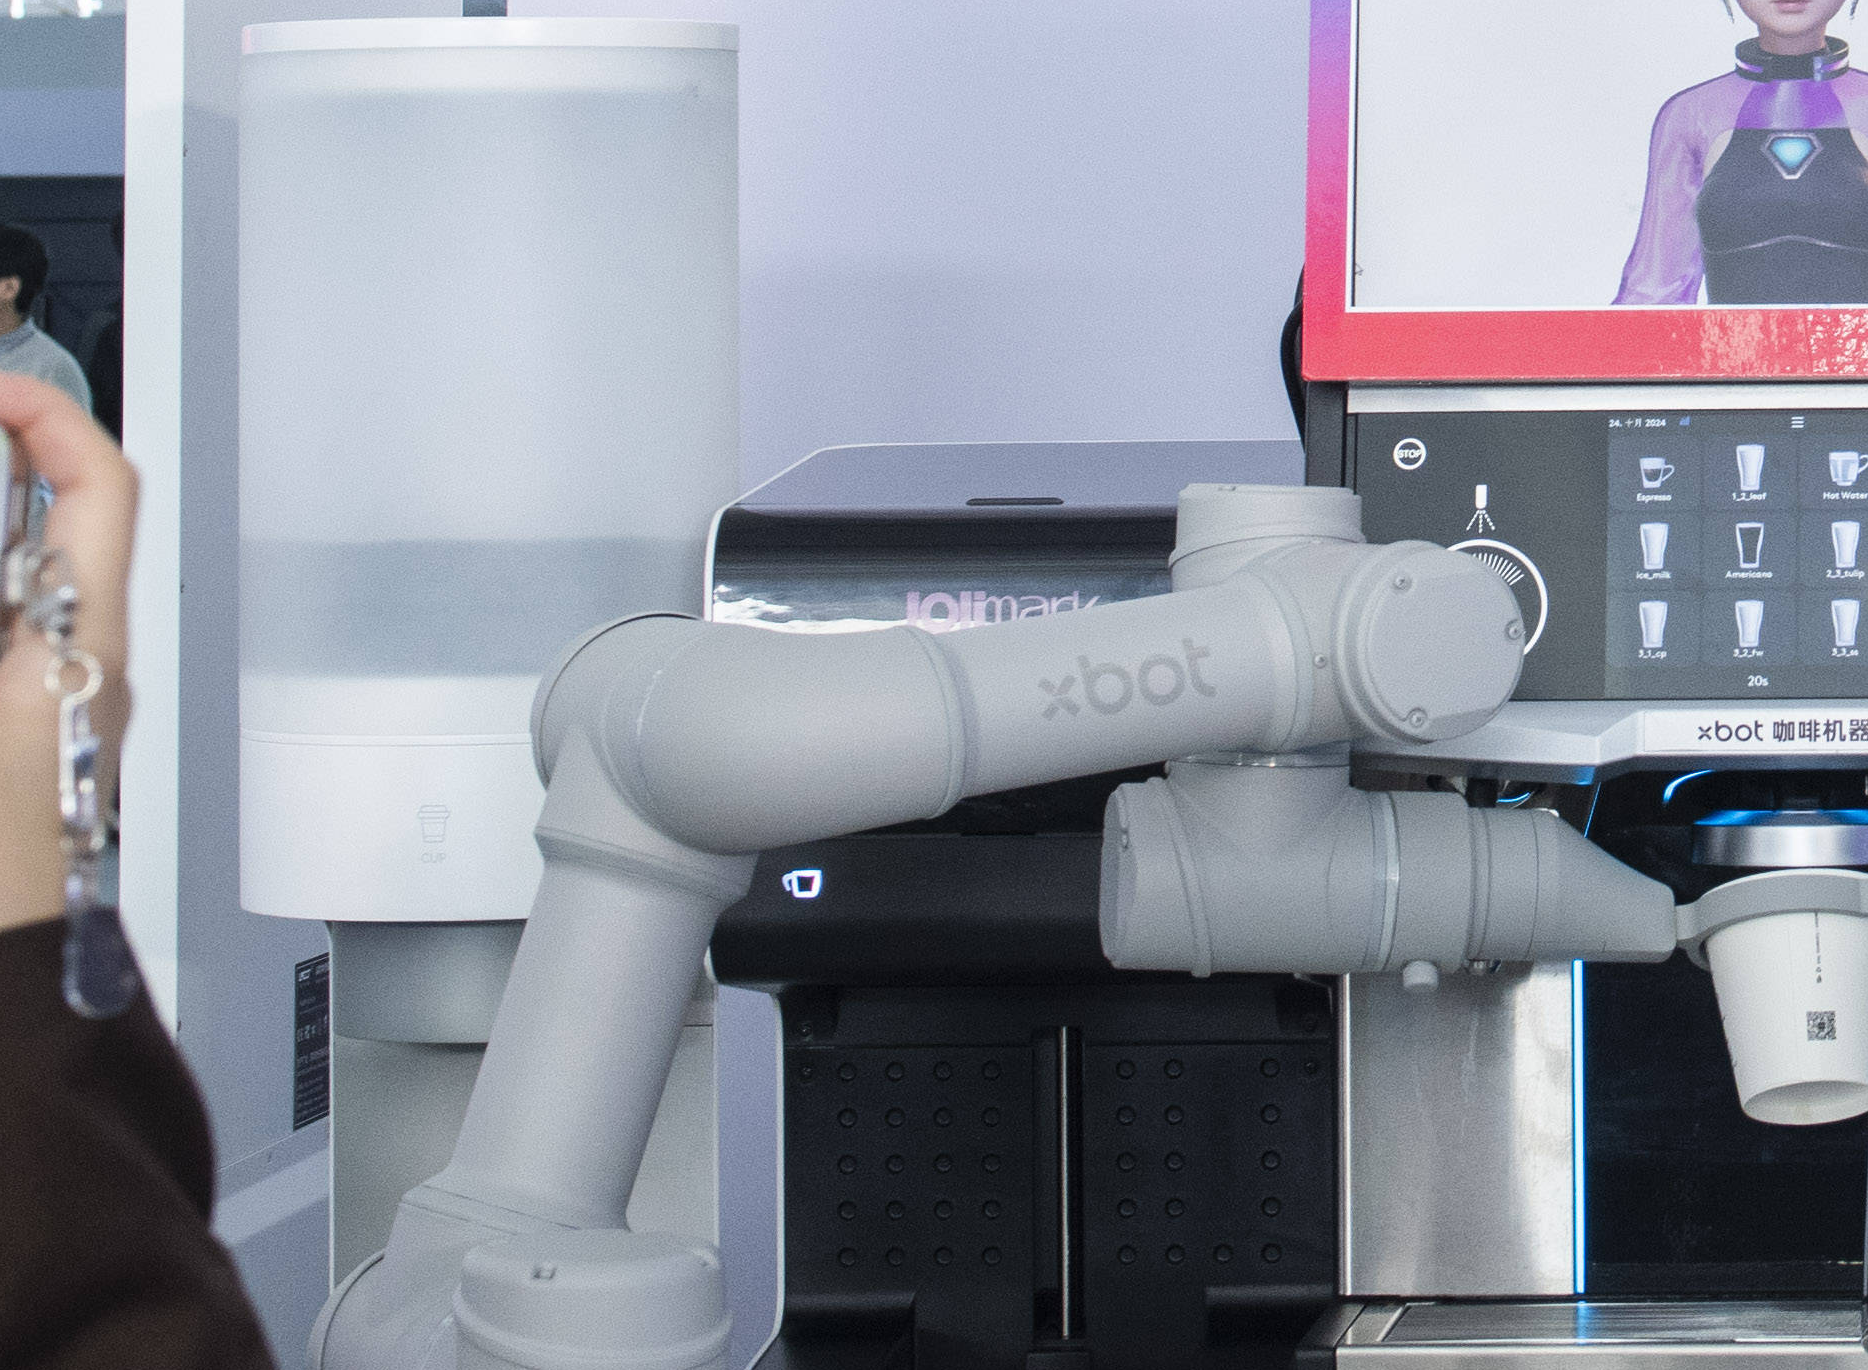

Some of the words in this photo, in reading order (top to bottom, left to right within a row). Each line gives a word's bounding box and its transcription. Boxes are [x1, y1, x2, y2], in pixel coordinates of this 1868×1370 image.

[1644, 417, 1668, 428] 2024
[1636, 492, 1673, 503] Espresso
[1822, 490, 1840, 501] Hot
[1841, 490, 1868, 501] Water
[1725, 570, 1773, 580] Americano
[1037, 637, 1218, 722] xbot
[1746, 675, 1770, 688] 20s
[1697, 720, 1765, 744] xbot
[420, 851, 447, 864] CUP
